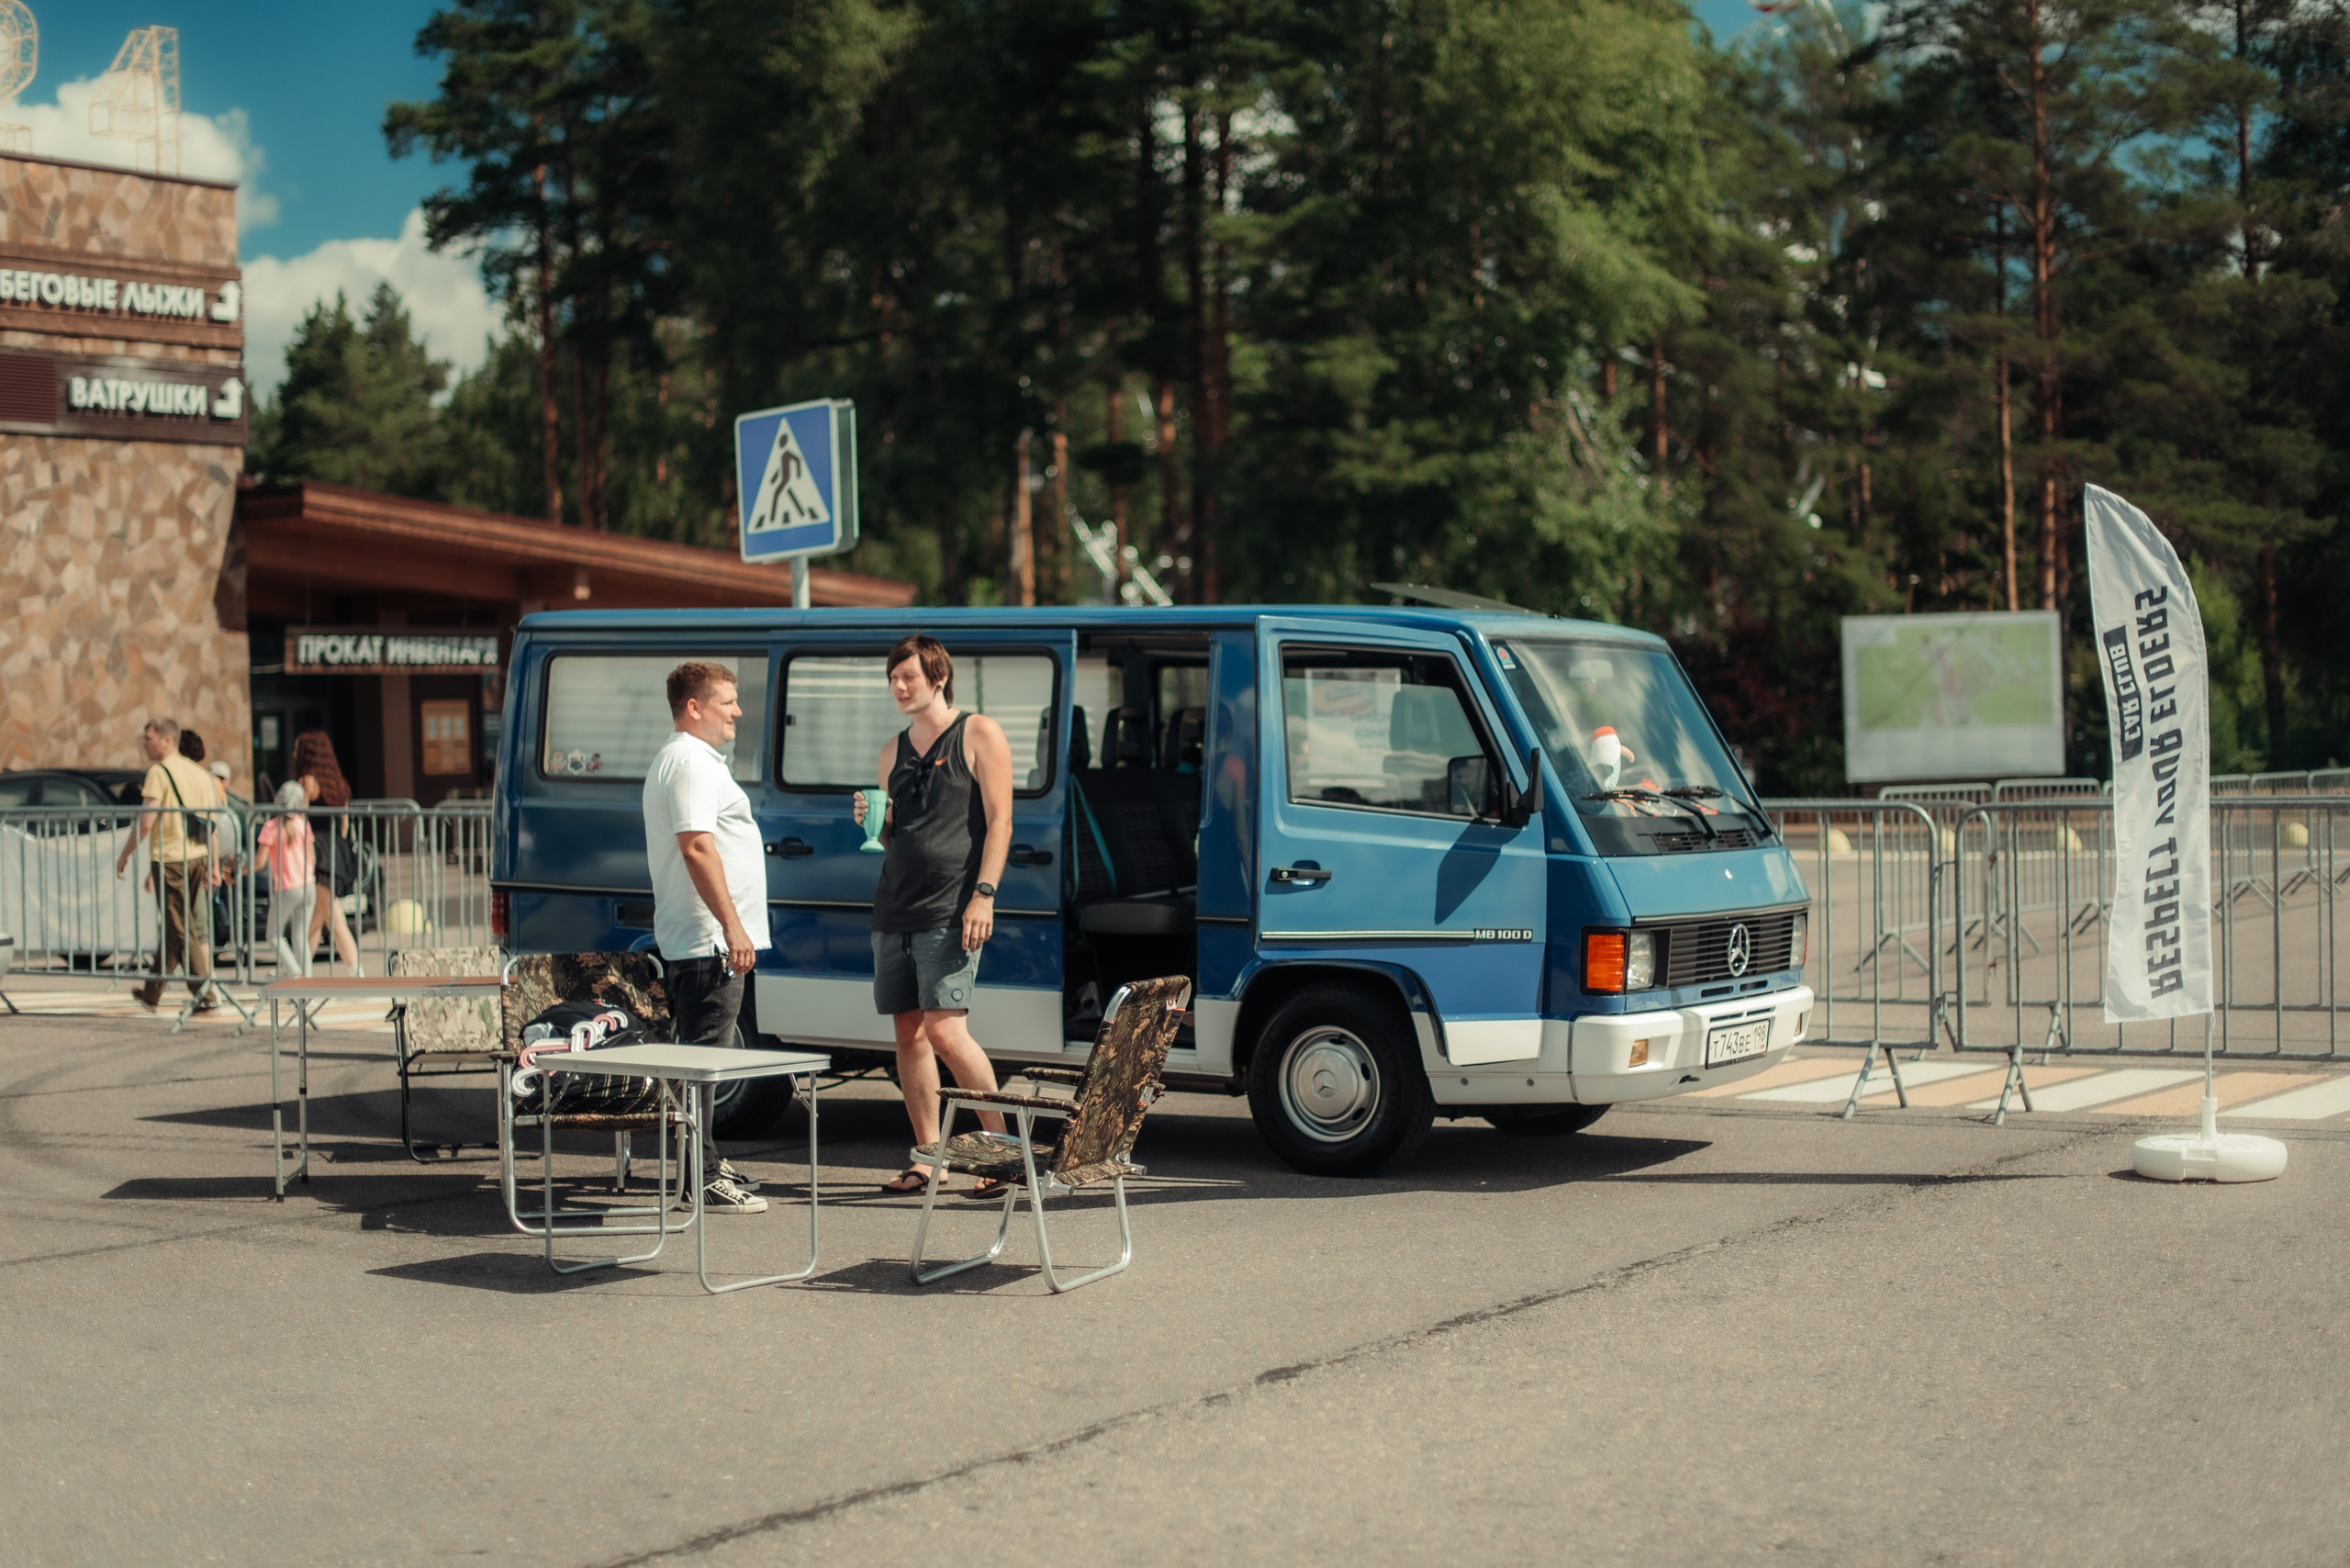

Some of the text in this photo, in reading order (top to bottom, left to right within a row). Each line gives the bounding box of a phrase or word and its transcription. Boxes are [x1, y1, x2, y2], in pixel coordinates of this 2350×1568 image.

[0, 269, 205, 319] БЕГОВЫЕ ЛЫЖИ
[71, 376, 207, 416] ВАТРУШКИ
[297, 634, 384, 665] ПРОКАТ
[1475, 930, 1532, 939] MB 100 D
